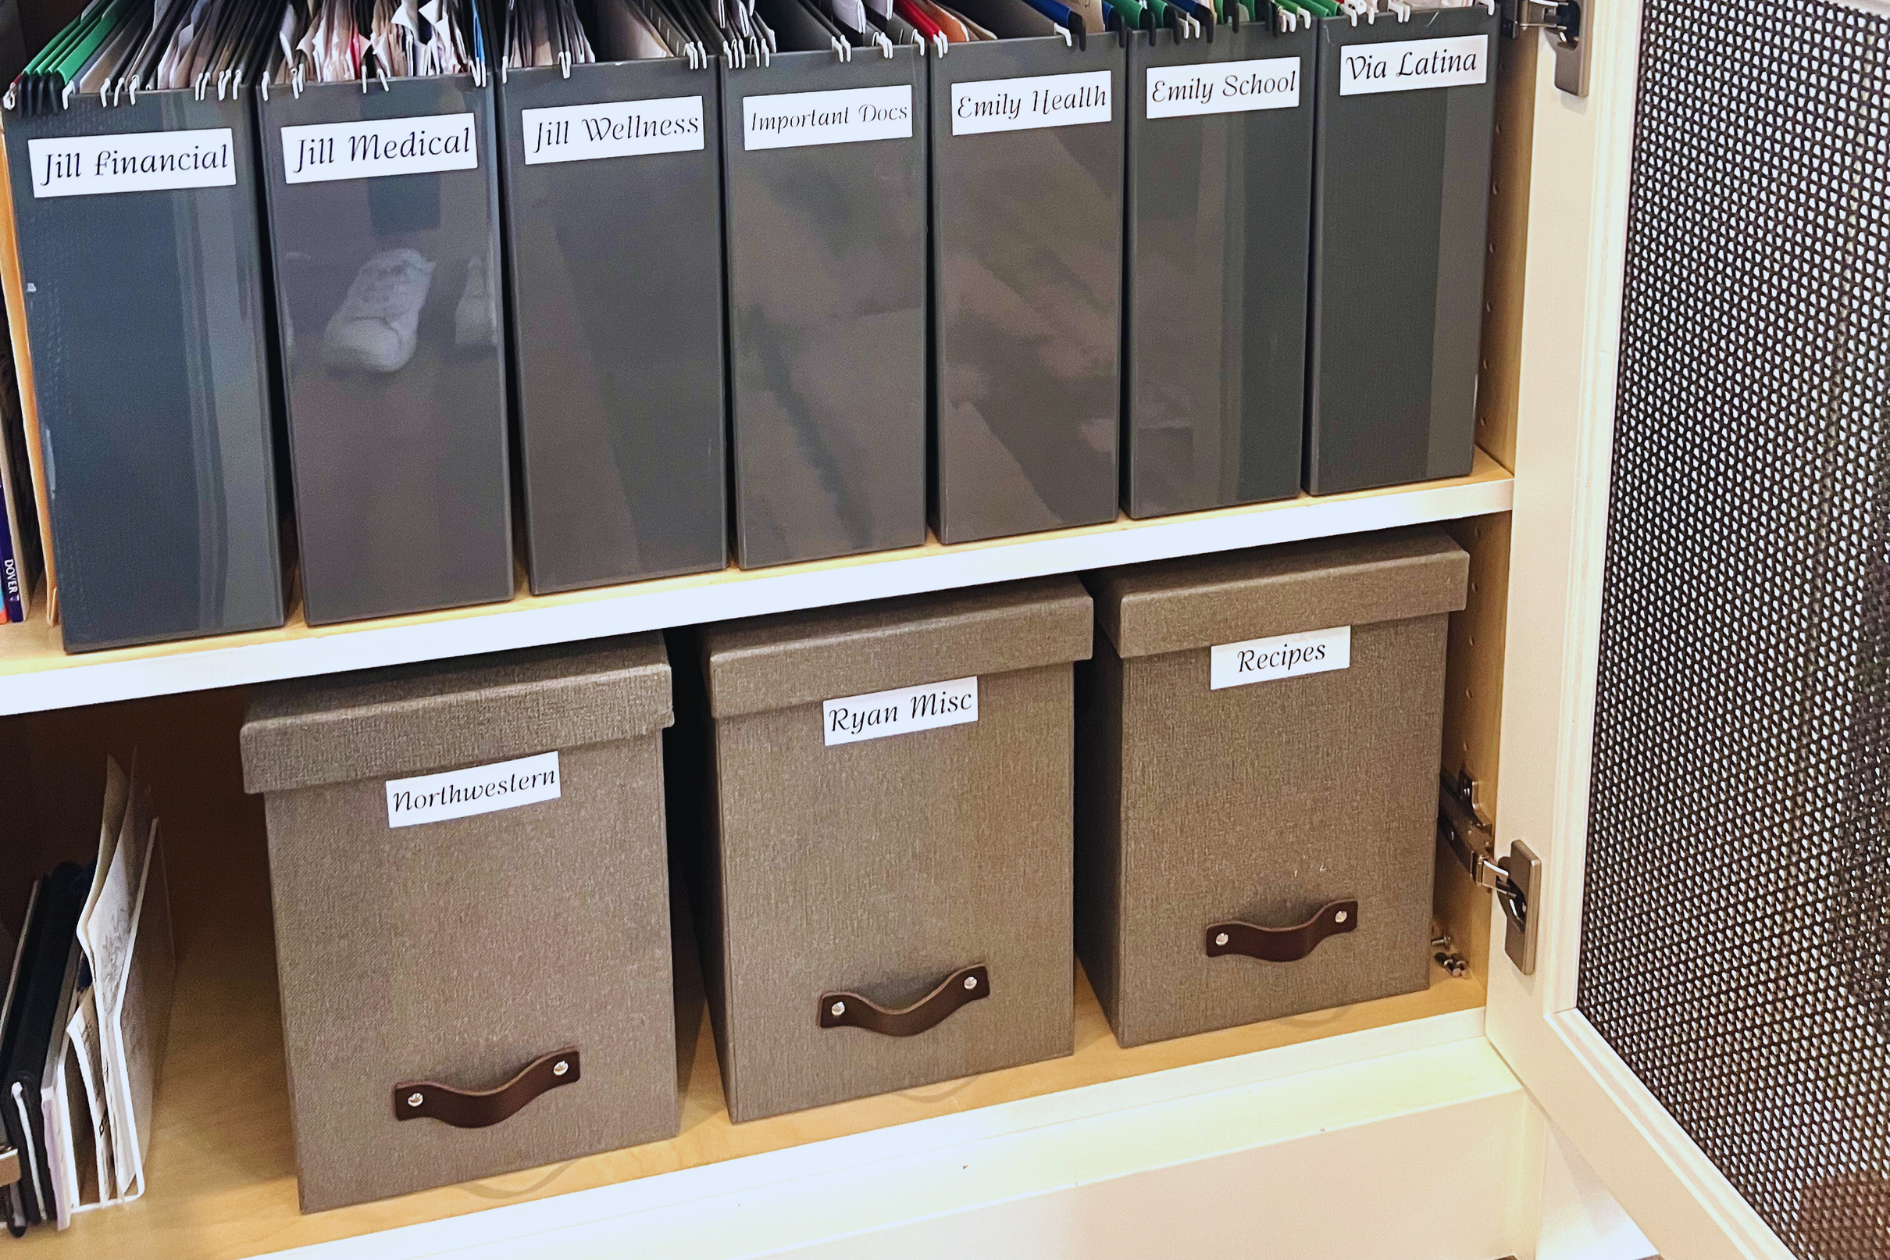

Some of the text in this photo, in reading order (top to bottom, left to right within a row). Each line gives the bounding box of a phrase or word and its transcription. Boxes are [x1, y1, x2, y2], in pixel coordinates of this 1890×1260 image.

[1344, 49, 1478, 83] Via Latina
[956, 86, 1108, 125] Emily Health
[1150, 70, 1296, 107] Emily School
[532, 113, 699, 153] Jill Wellness
[750, 102, 908, 134] Important Docs
[39, 144, 229, 187] Jill Financial
[291, 126, 471, 174] Jill Medical
[4, 559, 18, 594] DOVER
[1237, 644, 1326, 672] Recipes
[827, 691, 972, 737] Ryan Misc
[394, 768, 556, 815] Northwestern
